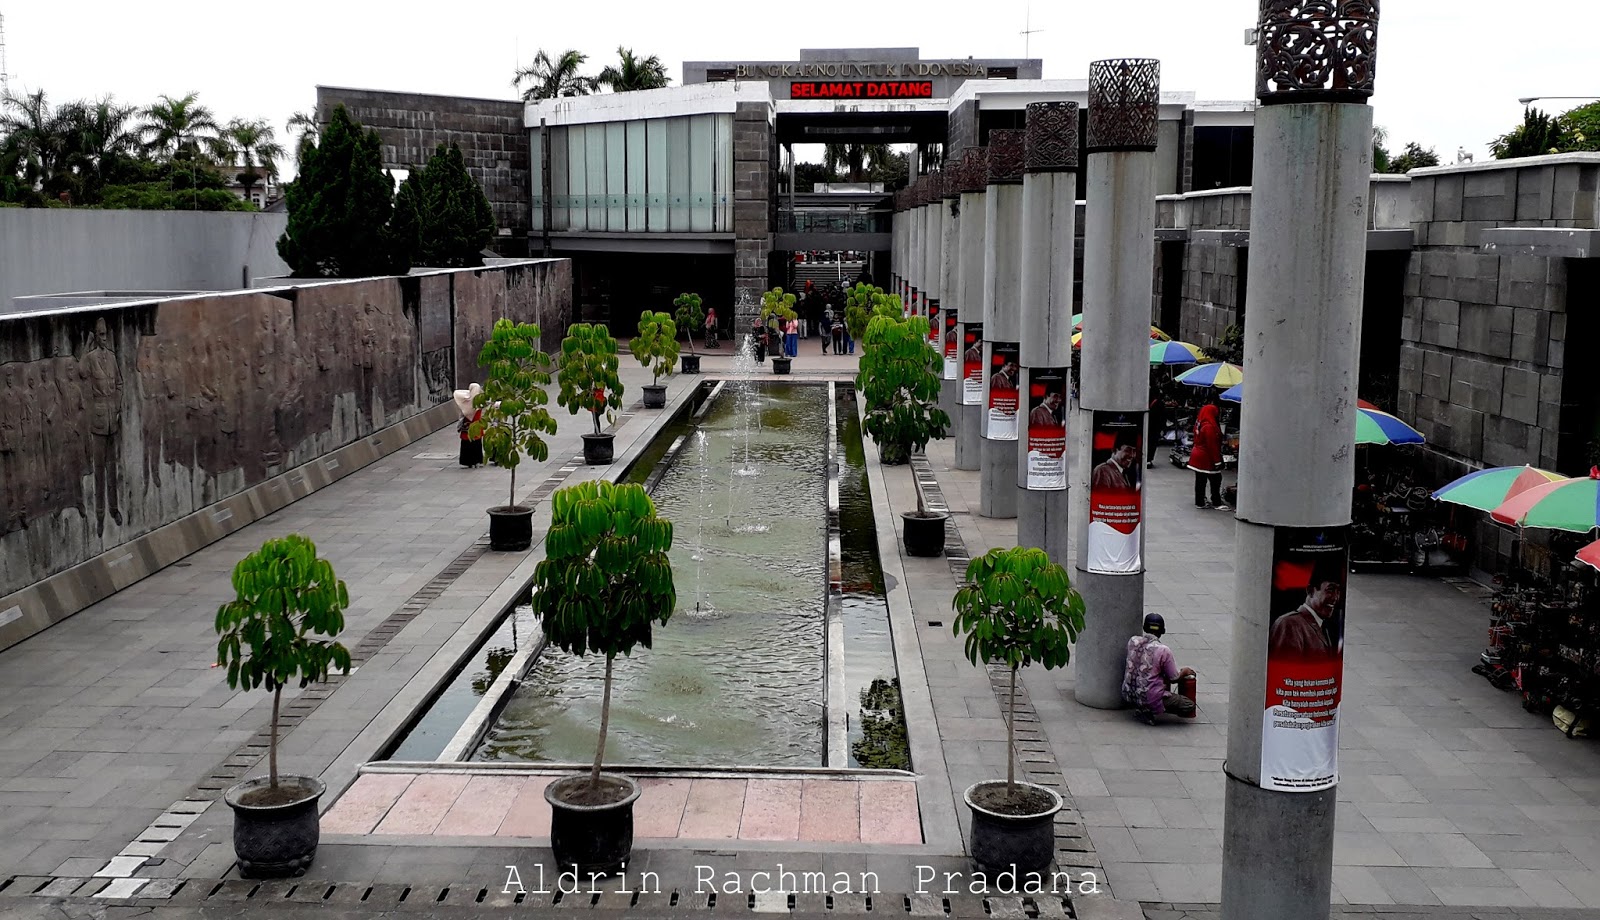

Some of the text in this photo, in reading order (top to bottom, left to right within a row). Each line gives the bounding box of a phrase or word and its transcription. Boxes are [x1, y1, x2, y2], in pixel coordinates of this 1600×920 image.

[841, 62, 896, 76] UNTUK
[901, 62, 985, 76] INDONESIA
[791, 82, 932, 98] SELAMAT DATANG
